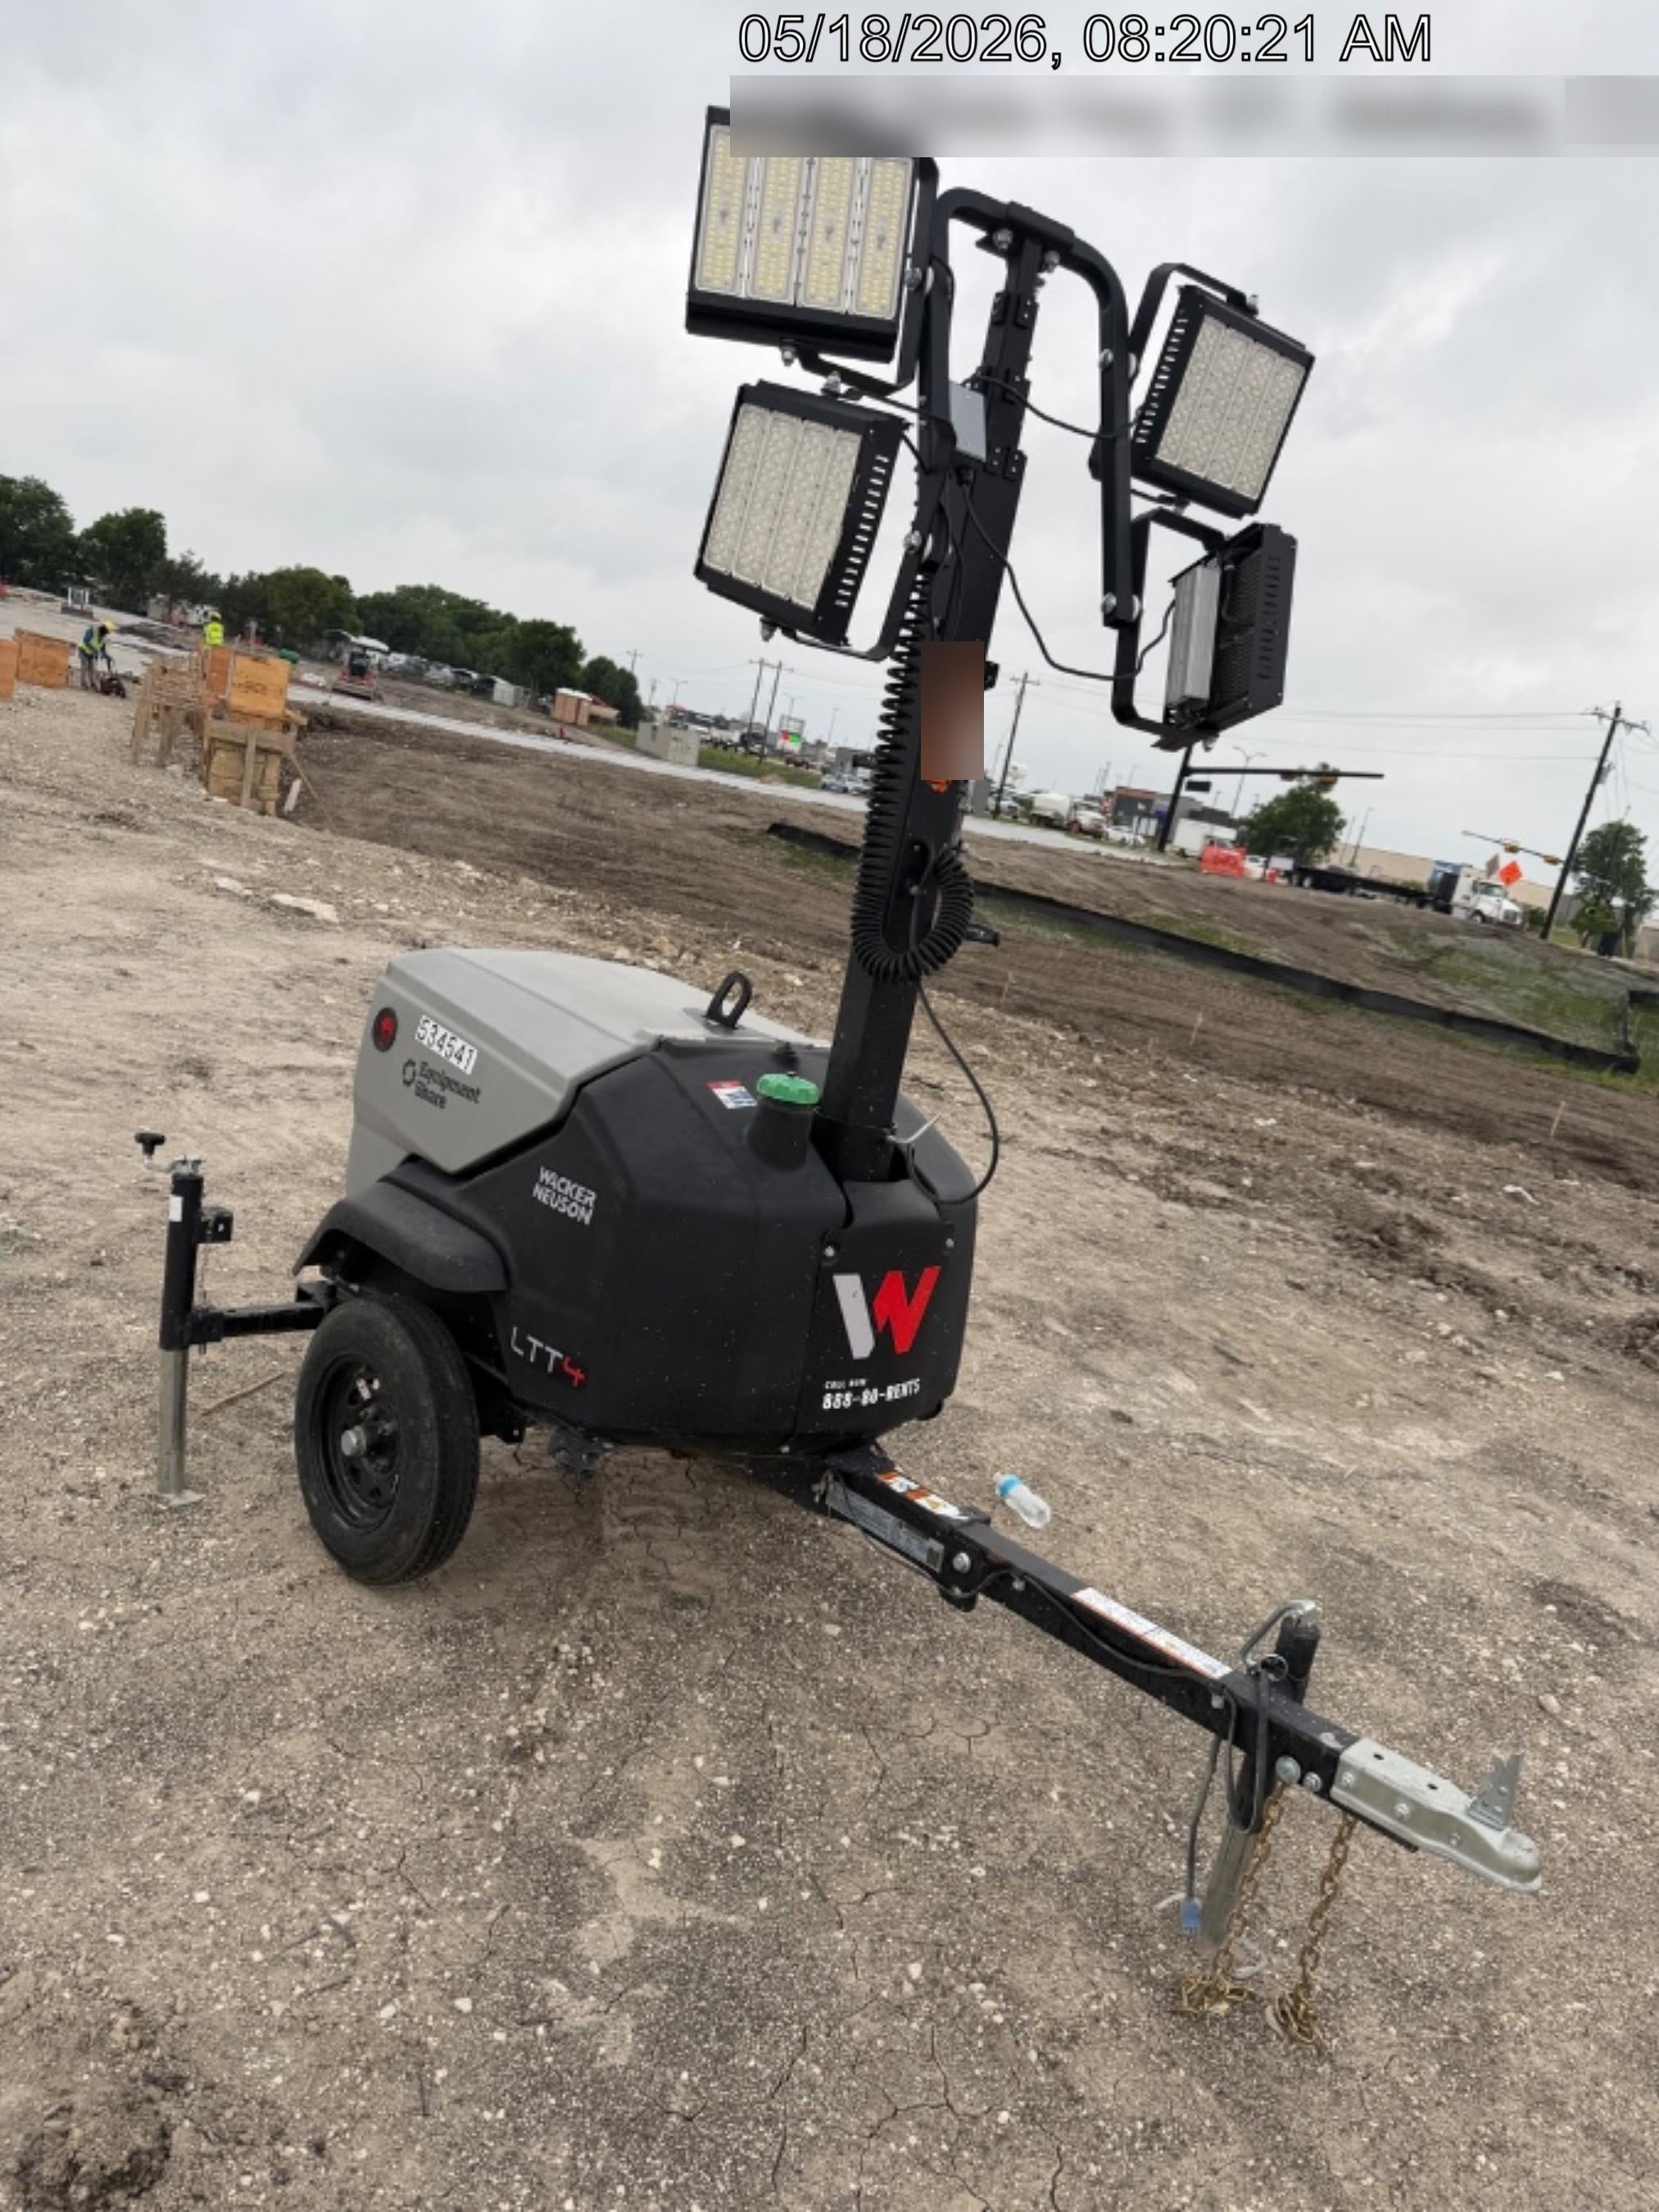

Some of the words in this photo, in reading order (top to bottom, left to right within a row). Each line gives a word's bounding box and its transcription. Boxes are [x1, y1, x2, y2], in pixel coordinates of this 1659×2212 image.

[417, 1018, 475, 1070] 534541
[419, 1061, 481, 1104] Equipment
[532, 1182, 594, 1226] NEUSON
[539, 1165, 597, 1207] WACKER
[510, 1325, 587, 1389] LTT4
